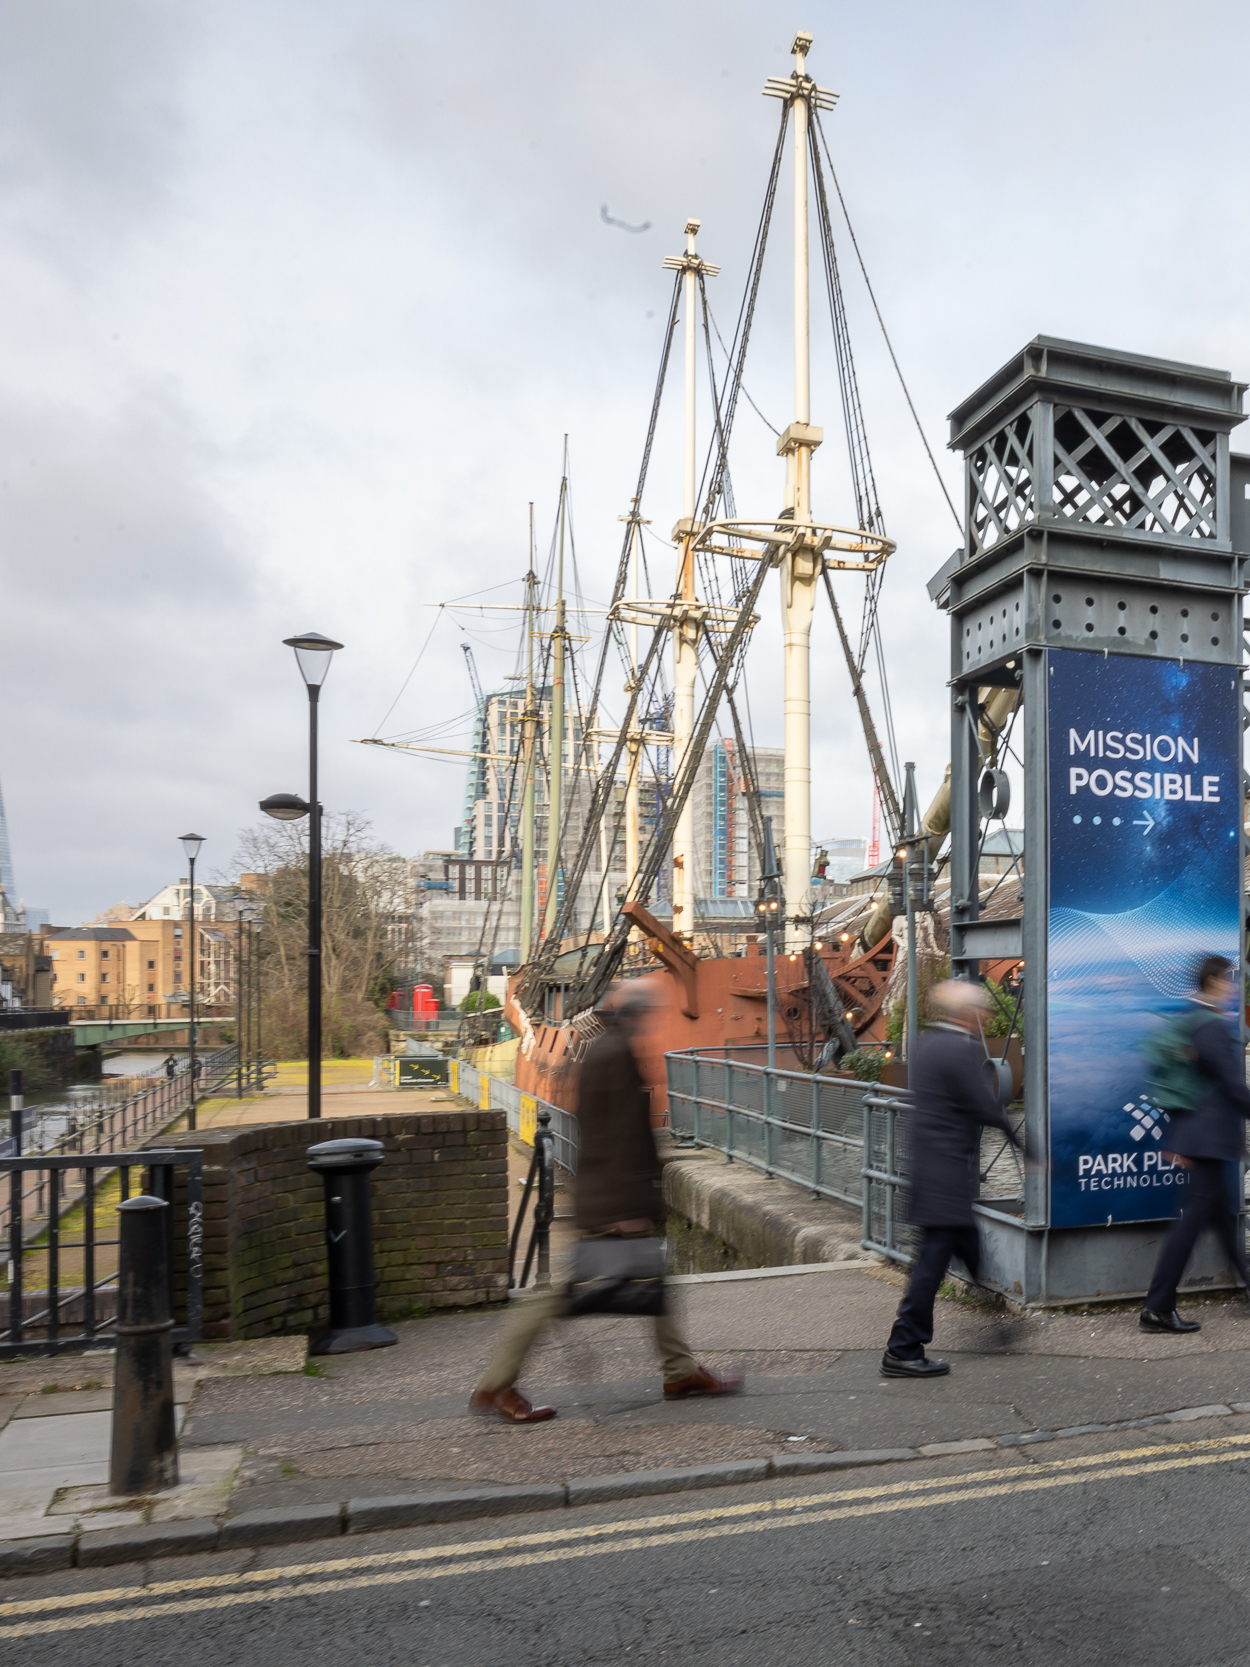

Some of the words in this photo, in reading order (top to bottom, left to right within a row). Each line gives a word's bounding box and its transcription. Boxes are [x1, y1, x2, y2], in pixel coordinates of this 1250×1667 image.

[1069, 727, 1199, 764] MISSION
[1069, 766, 1221, 803] POSSIBLE
[1077, 1151, 1139, 1177] PARK
[1142, 1150, 1186, 1172] PLA
[1077, 1172, 1191, 1192] TECHNOLOGI
